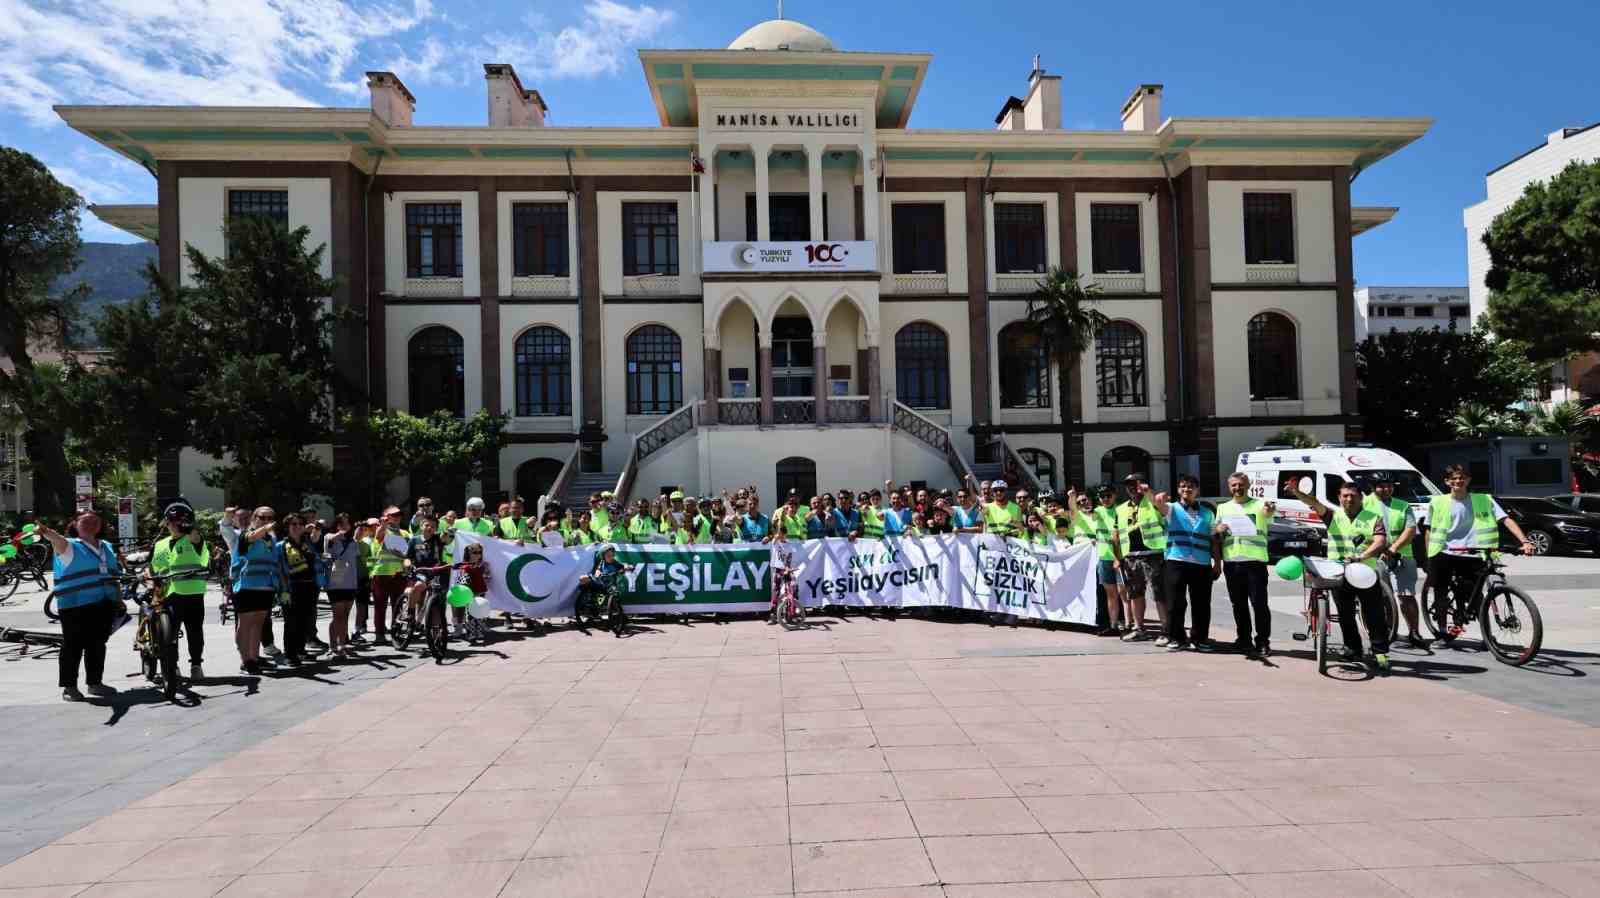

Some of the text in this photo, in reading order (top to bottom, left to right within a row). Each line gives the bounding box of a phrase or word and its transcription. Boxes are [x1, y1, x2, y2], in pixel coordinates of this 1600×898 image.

[717, 113, 778, 126] MANİSA
[1250, 486, 1264, 497] 112
[624, 554, 770, 600] YEŞİLAY
[806, 562, 939, 599] Yeşilaycısın
[984, 572, 1037, 594] SIZLIK
[994, 589, 1028, 608] YILI
